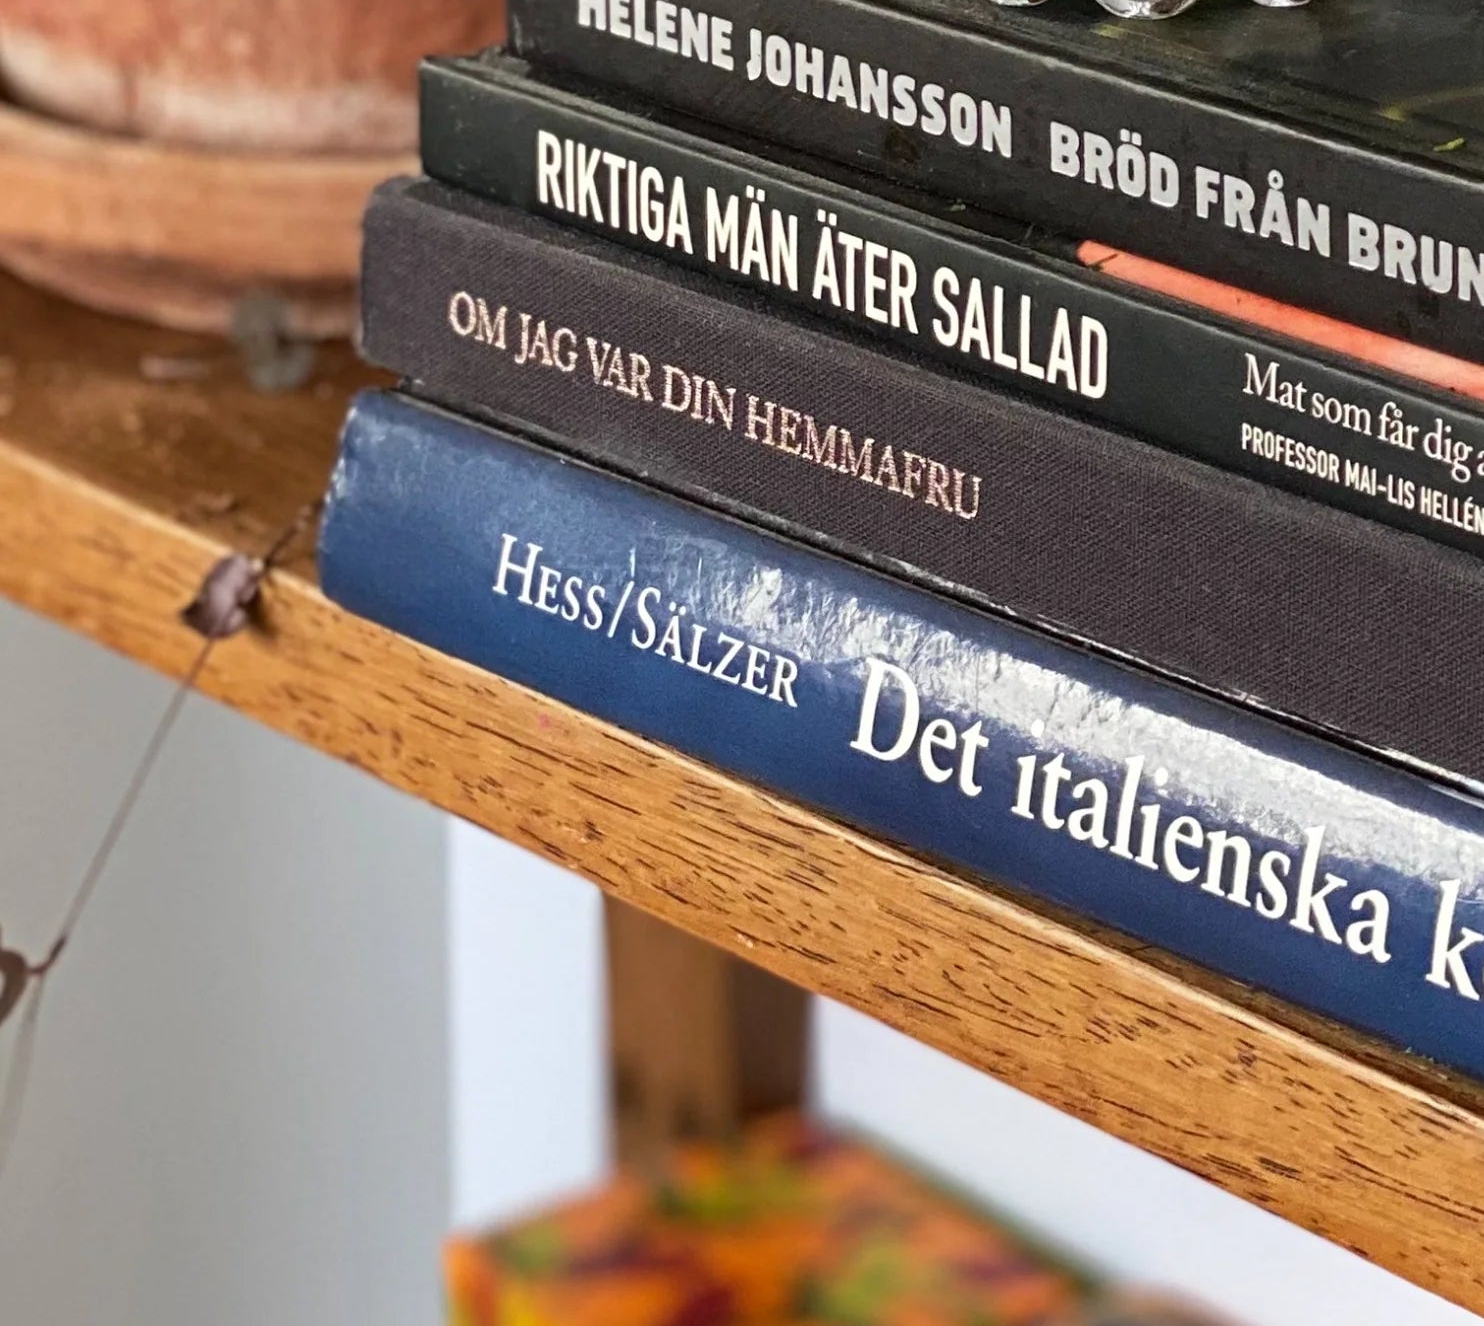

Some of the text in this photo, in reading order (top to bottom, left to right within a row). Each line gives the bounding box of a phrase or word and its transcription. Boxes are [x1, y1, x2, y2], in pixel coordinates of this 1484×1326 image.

[745, 27, 1012, 158] JOHANSSON
[1050, 121, 1179, 208] BRÖD
[1195, 165, 1331, 258] FRÅN
[536, 130, 1108, 401] RIKTIGA MÄN ÄTER SALLAD
[449, 291, 982, 521] OM JAG VAR DIN HEMMAFRU
[1241, 423, 1339, 481] PROFESSOR
[1345, 456, 1415, 511] MAI-LIS
[1242, 353, 1307, 413] Mat
[1310, 392, 1373, 438] som
[1377, 402, 1418, 451] får
[1423, 419, 1472, 482] dig
[849, 657, 989, 797] Det
[1011, 719, 1392, 963] italienska
